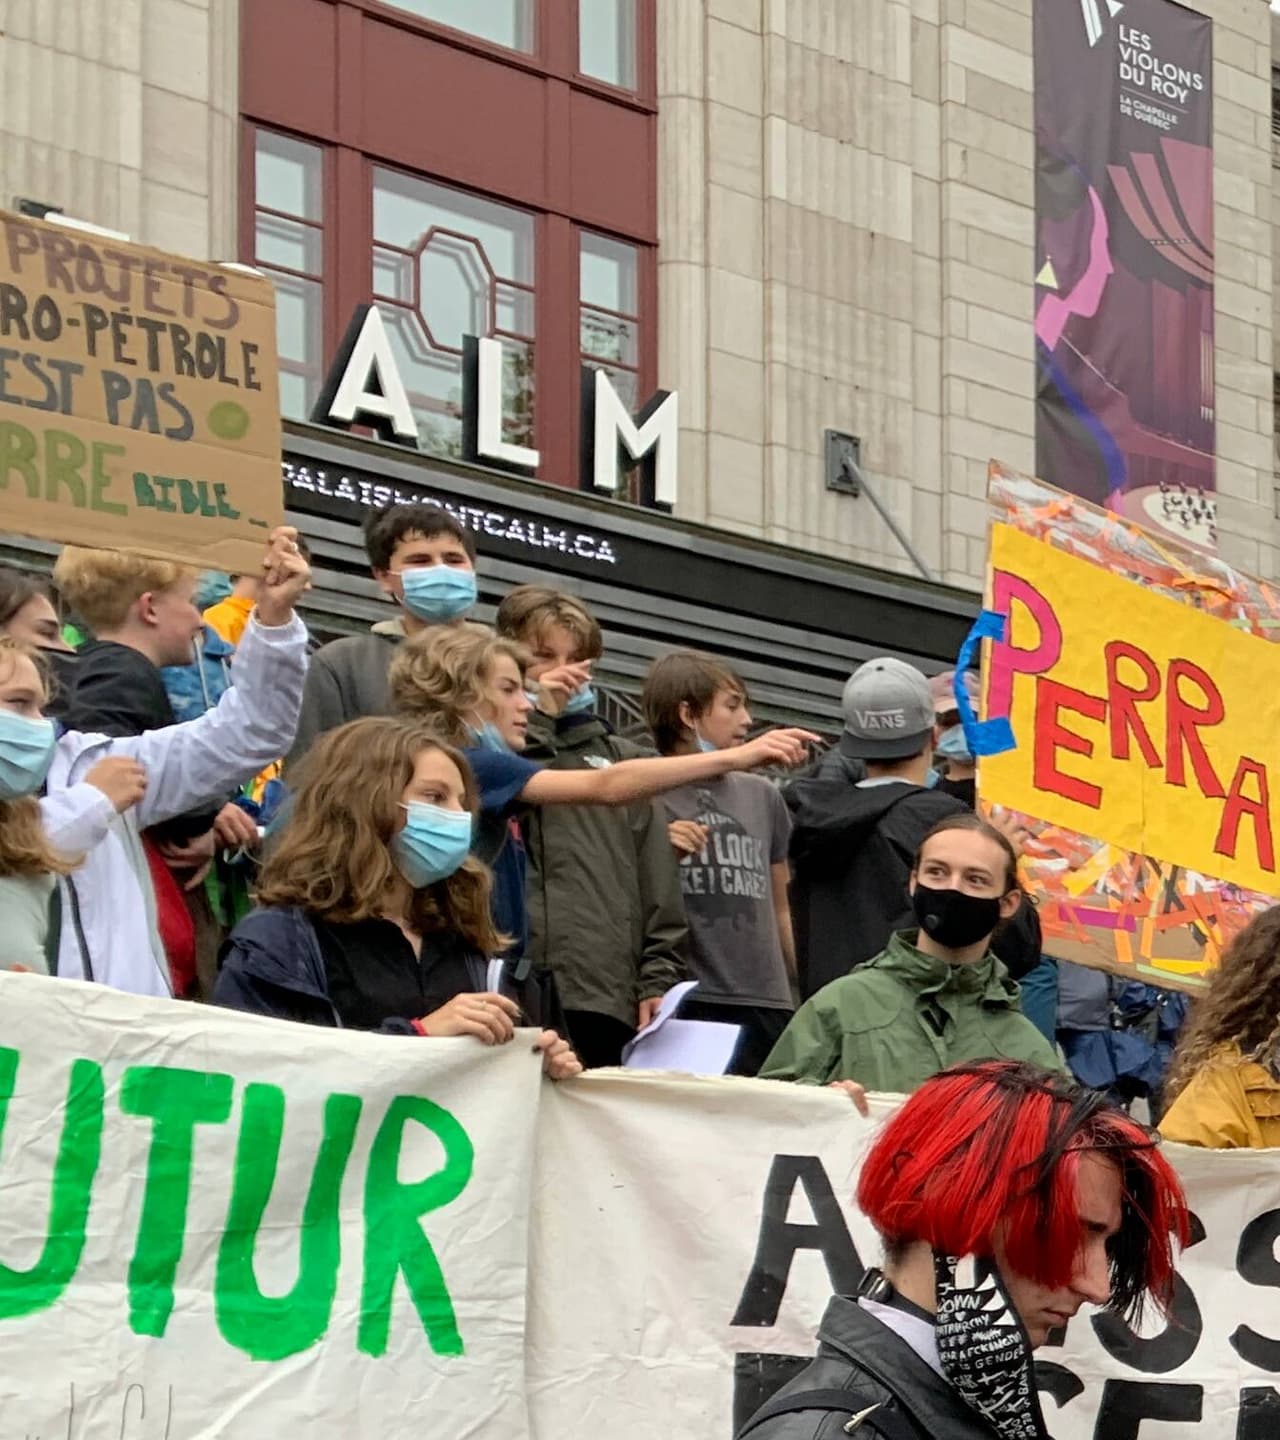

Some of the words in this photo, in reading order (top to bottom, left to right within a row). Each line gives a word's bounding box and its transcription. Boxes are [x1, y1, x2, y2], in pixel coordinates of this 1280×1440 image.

[1119, 24, 1151, 51] LES
[1119, 44, 1203, 90] VIOLONS
[1119, 62, 1146, 86] DU
[1151, 74, 1189, 104] ROY
[5, 222, 240, 331] PROJETS
[101, 369, 194, 442] PAS
[854, 708, 906, 730] VANS
